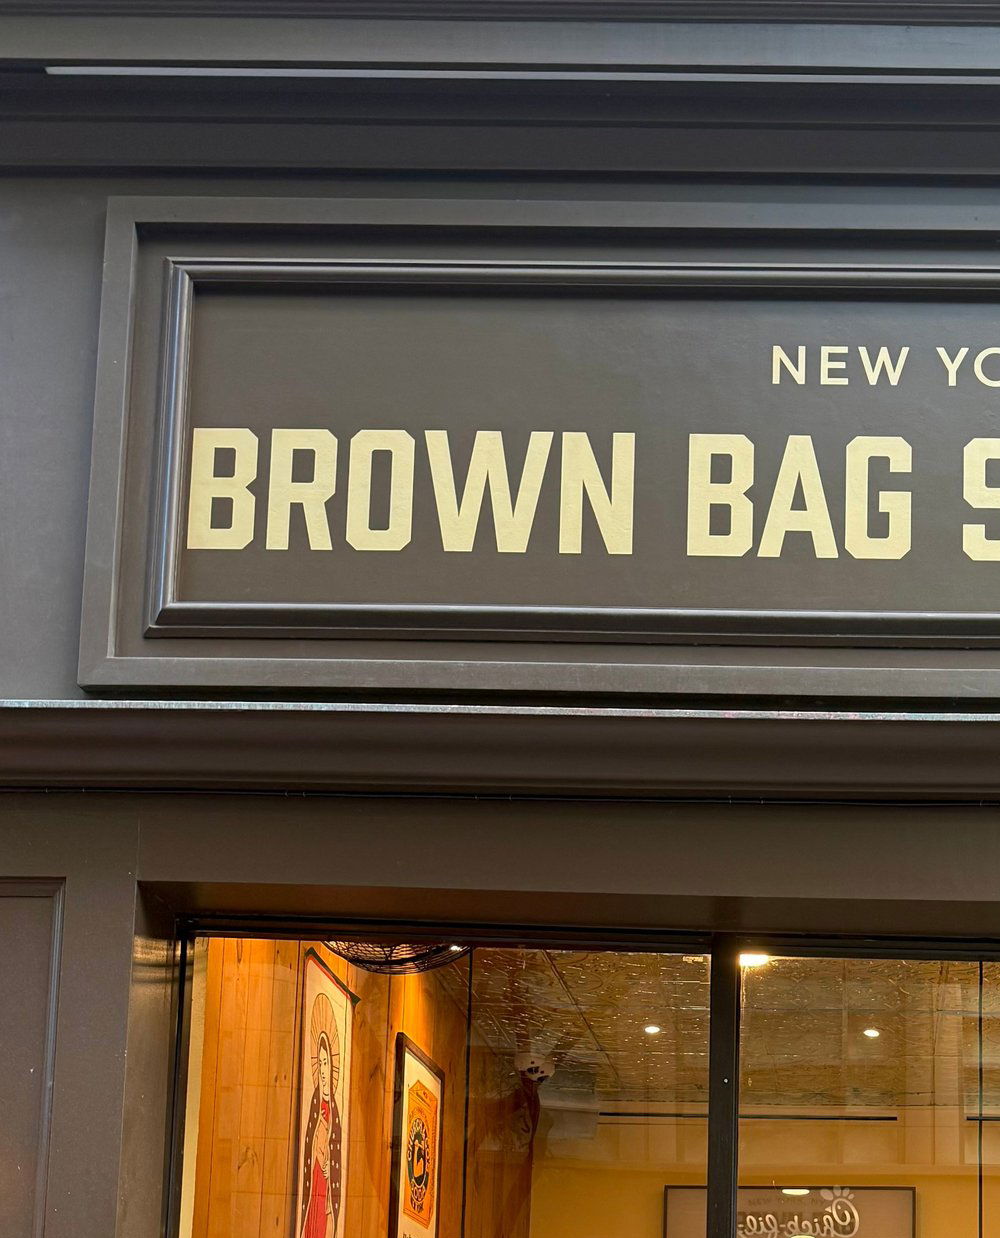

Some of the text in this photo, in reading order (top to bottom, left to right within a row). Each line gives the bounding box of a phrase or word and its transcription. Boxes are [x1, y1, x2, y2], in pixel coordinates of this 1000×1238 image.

[770, 344, 909, 388] NEW
[186, 426, 636, 556] BROWN
[686, 433, 913, 561] BAG
